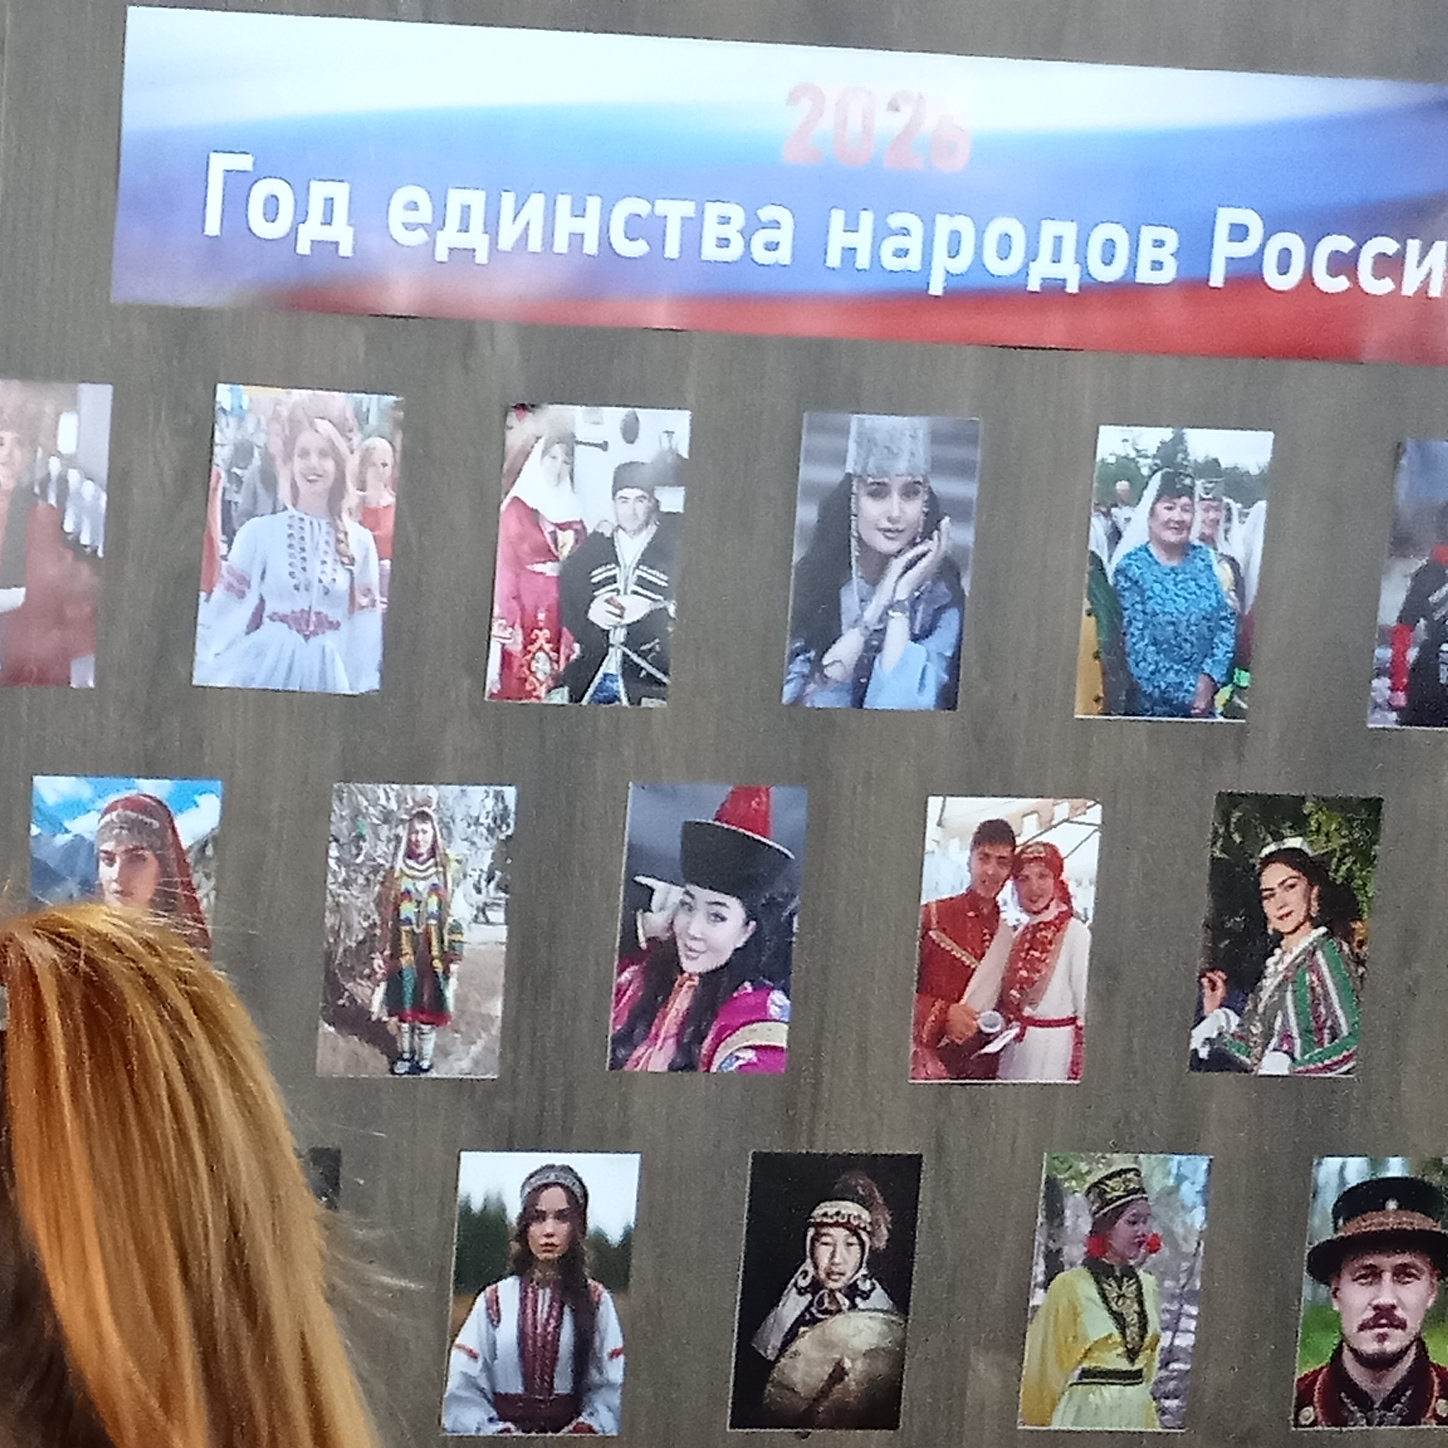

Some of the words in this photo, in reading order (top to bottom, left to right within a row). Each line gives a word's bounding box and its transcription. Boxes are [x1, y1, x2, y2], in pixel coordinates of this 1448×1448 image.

[784, 82, 972, 172] 2026
[202, 150, 355, 259] Год
[386, 183, 796, 269] единства
[825, 204, 1178, 297] народов
